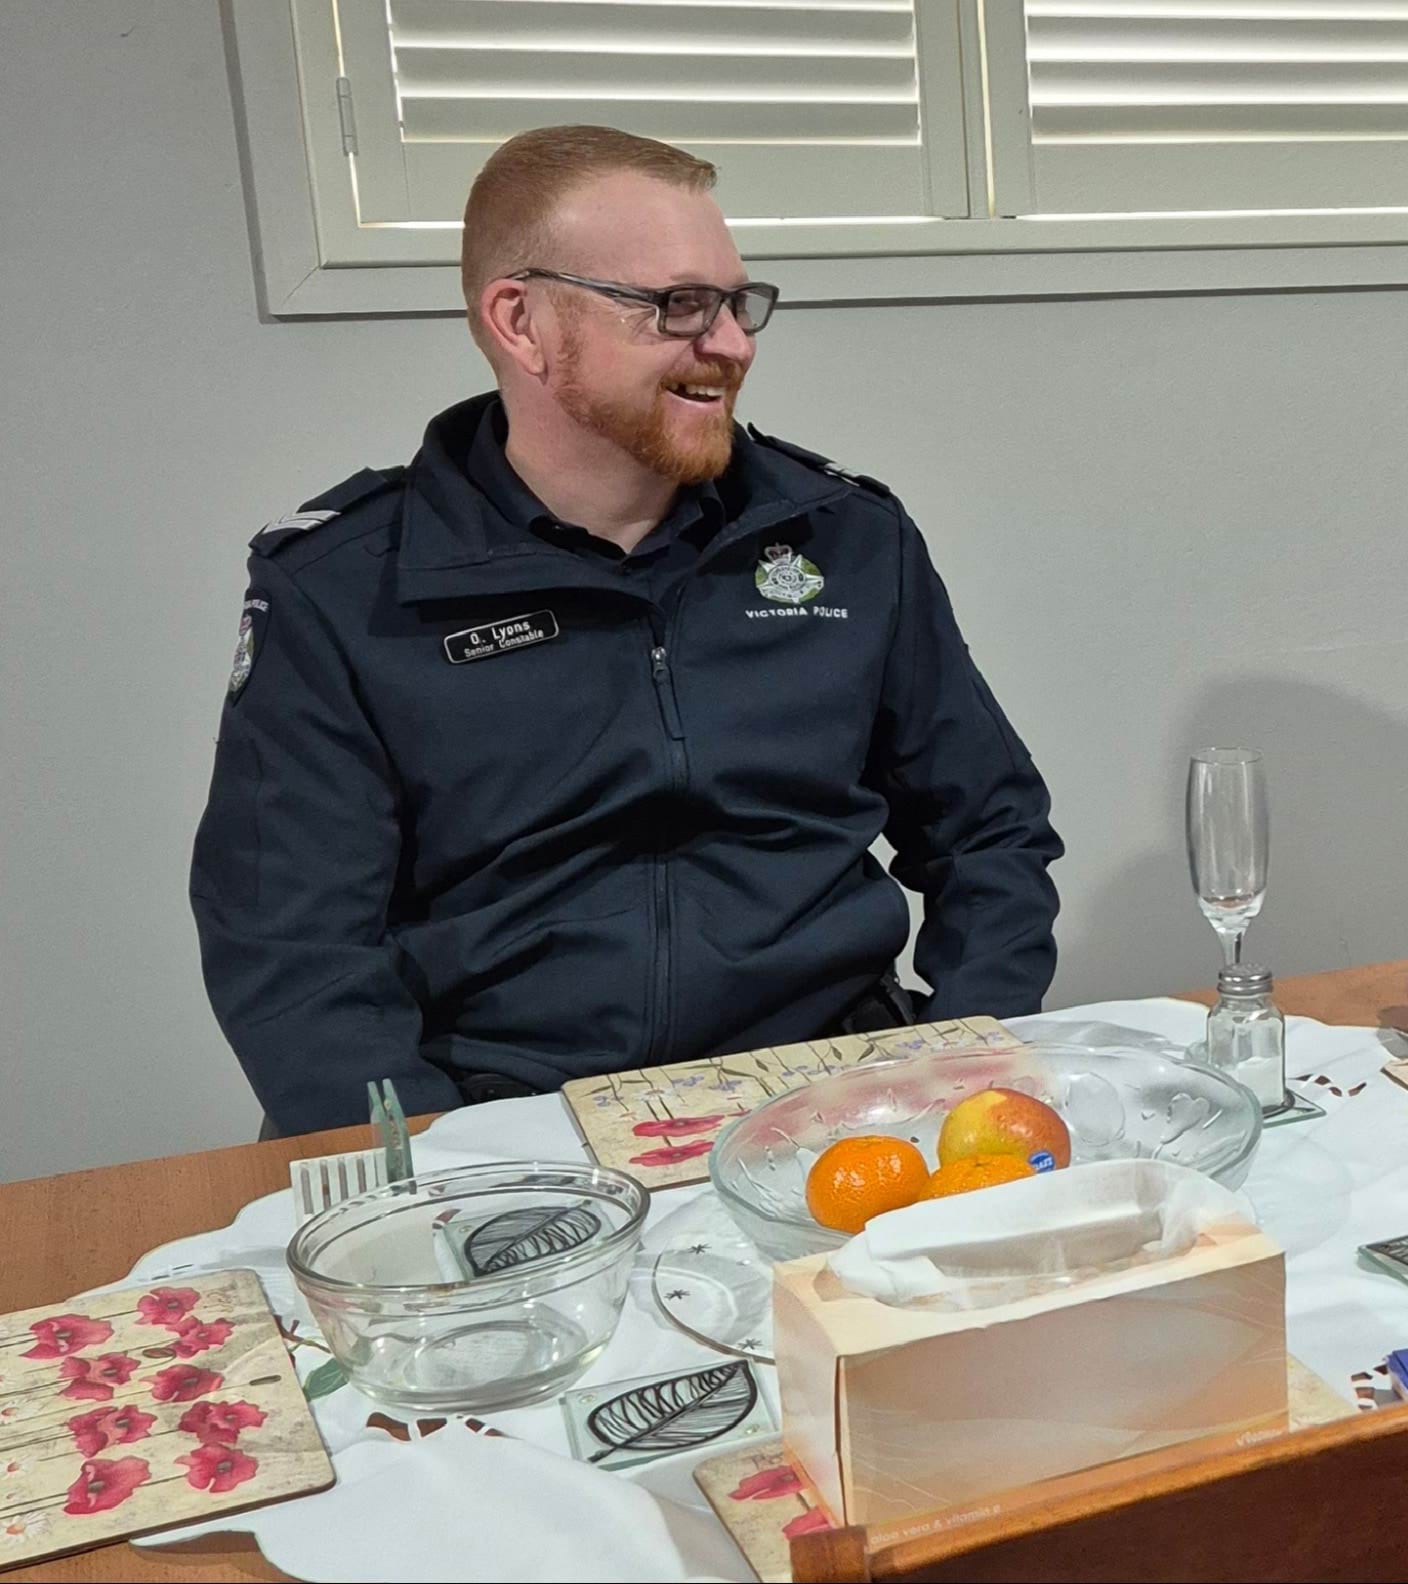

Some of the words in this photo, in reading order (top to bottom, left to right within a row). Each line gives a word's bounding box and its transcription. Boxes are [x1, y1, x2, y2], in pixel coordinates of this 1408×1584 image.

[745, 607, 808, 618] VICTORIA
[813, 606, 848, 618] POLICE
[491, 621, 530, 641] Lyons
[463, 643, 494, 658] Senior
[498, 629, 544, 648] Constable
